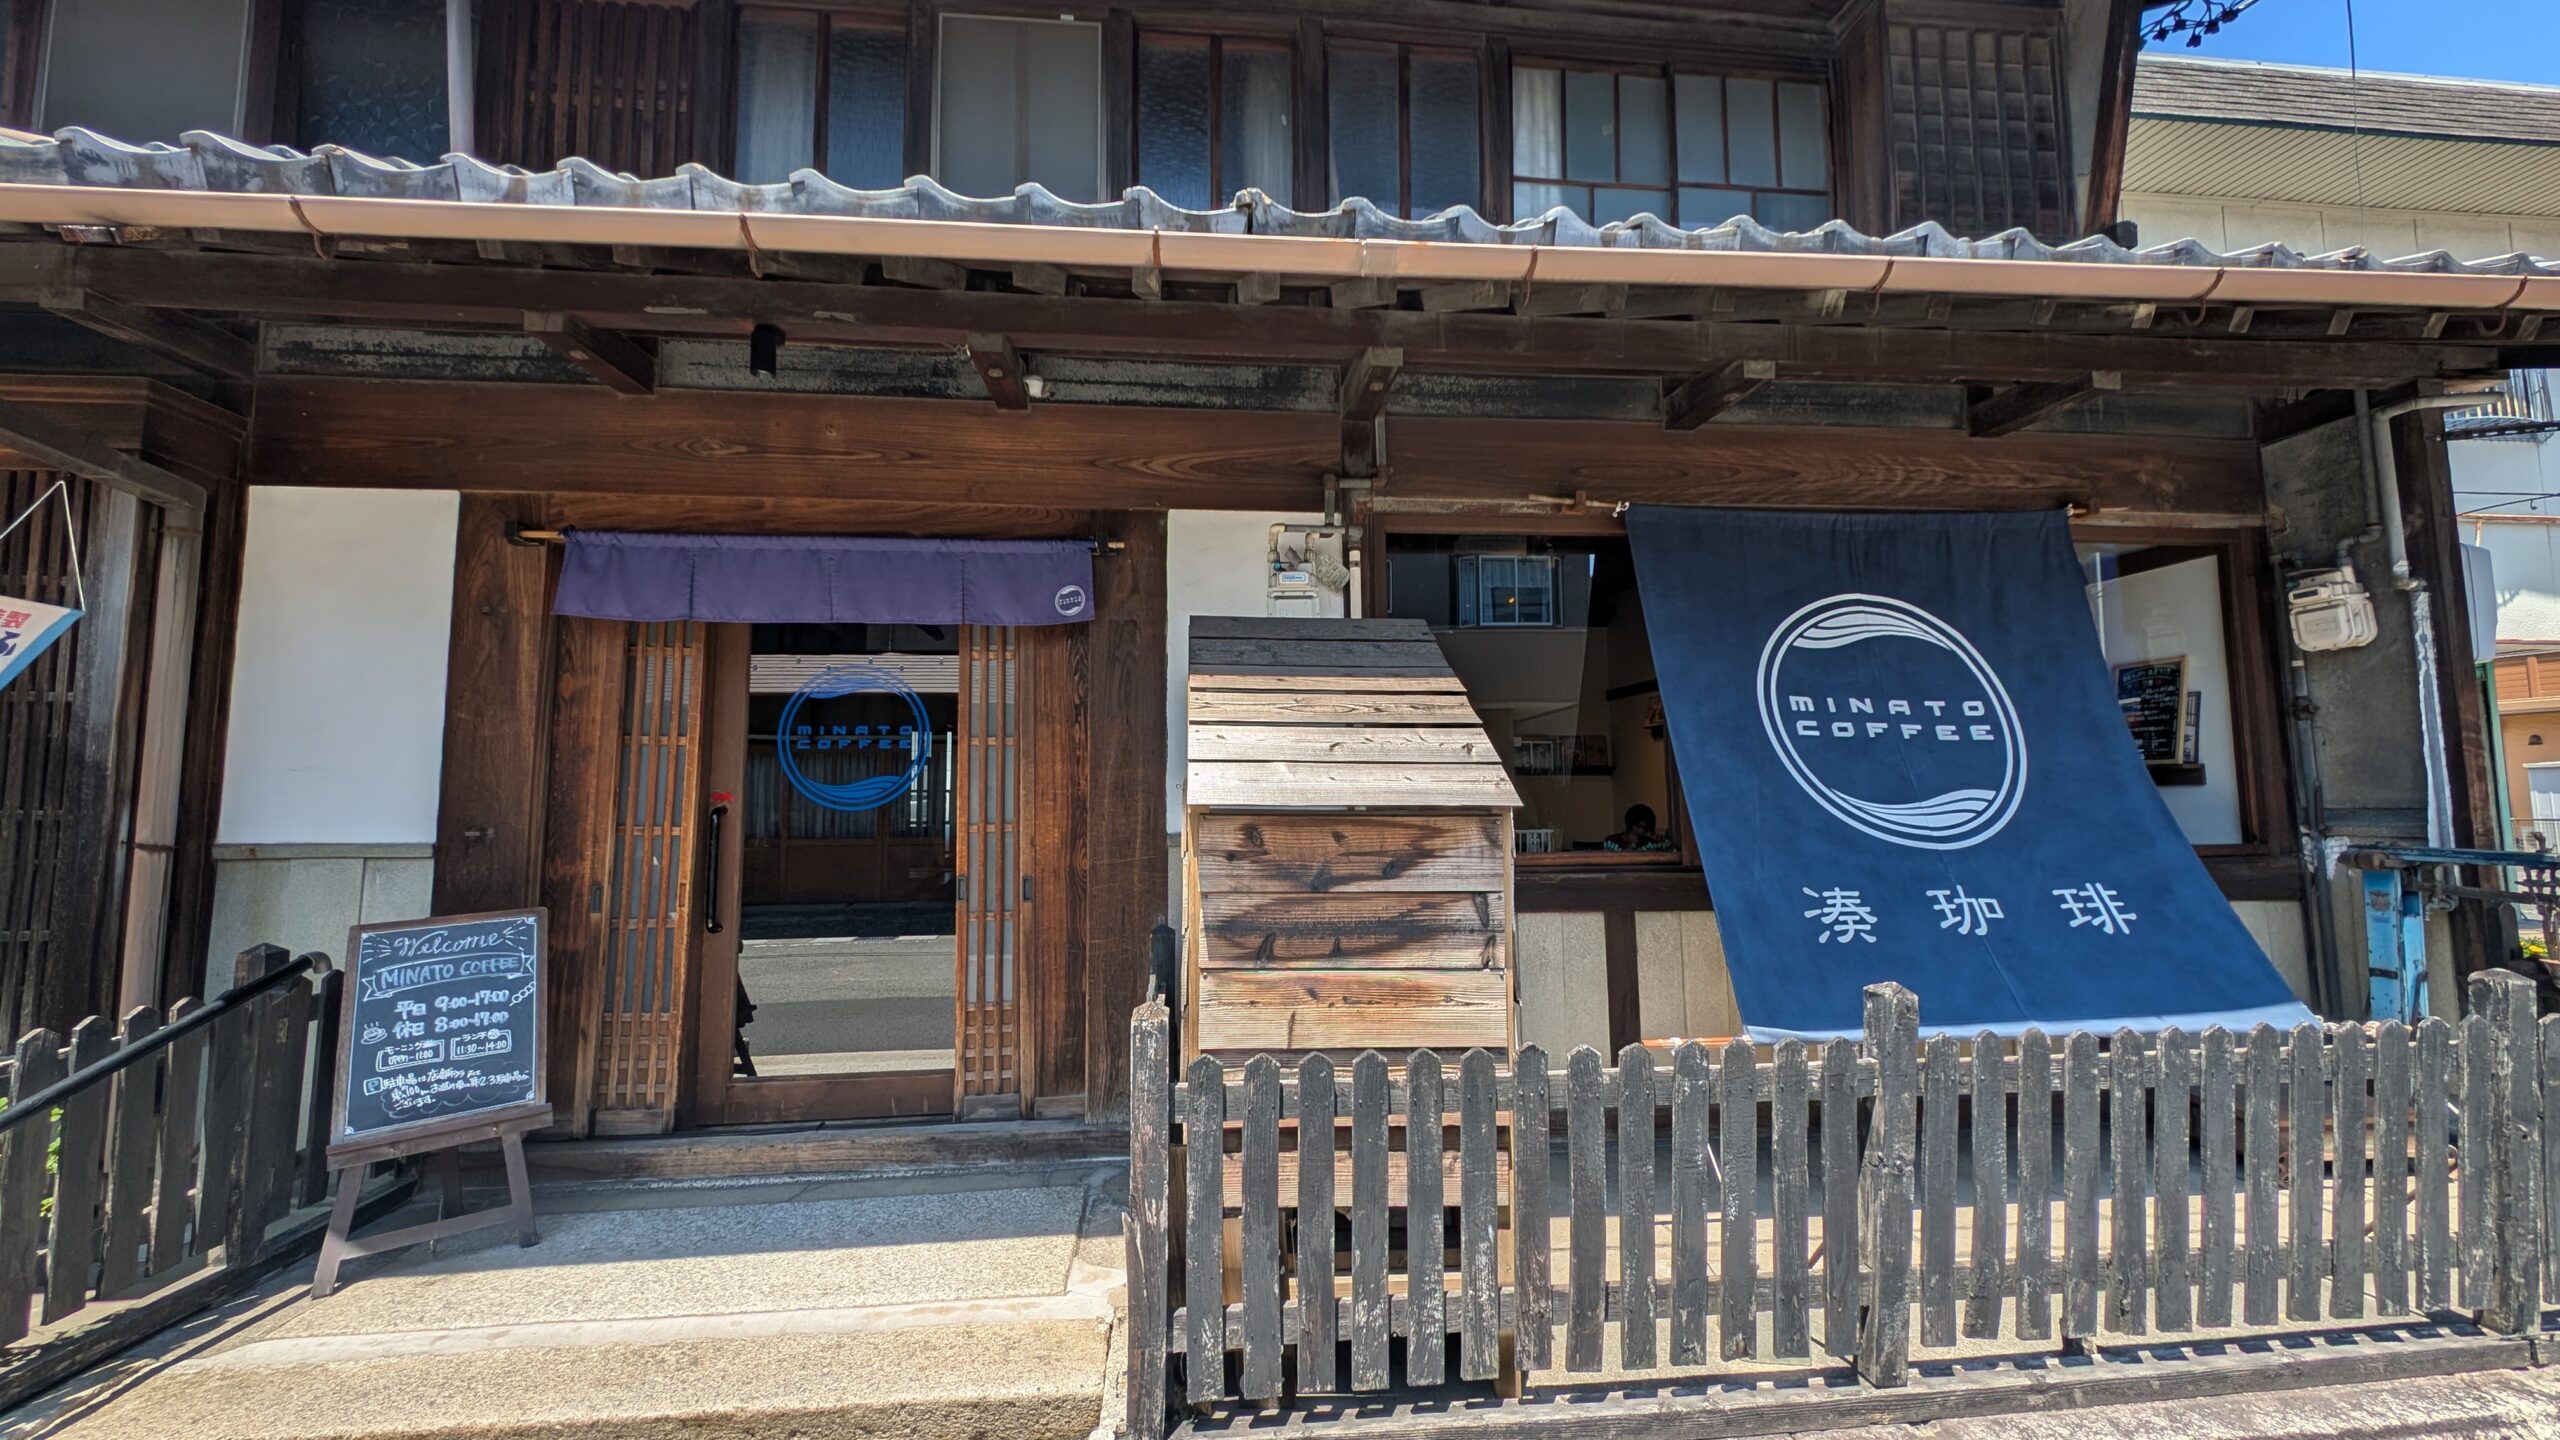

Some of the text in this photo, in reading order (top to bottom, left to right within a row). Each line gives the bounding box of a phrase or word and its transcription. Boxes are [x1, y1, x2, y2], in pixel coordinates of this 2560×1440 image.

[1788, 695, 1985, 717] MINATO
[797, 725, 913, 736] MINATO
[1796, 720, 1995, 741] COFFEE
[796, 738, 913, 749] COFFEE
[1802, 882, 2137, 943] 湊珈琲
[393, 930, 503, 957] Welcome
[381, 956, 519, 990] MINATO COFFEE
[393, 1000, 427, 1020] 平日
[392, 1020, 425, 1039] 休日
[385, 1041, 422, 1055] モーニング
